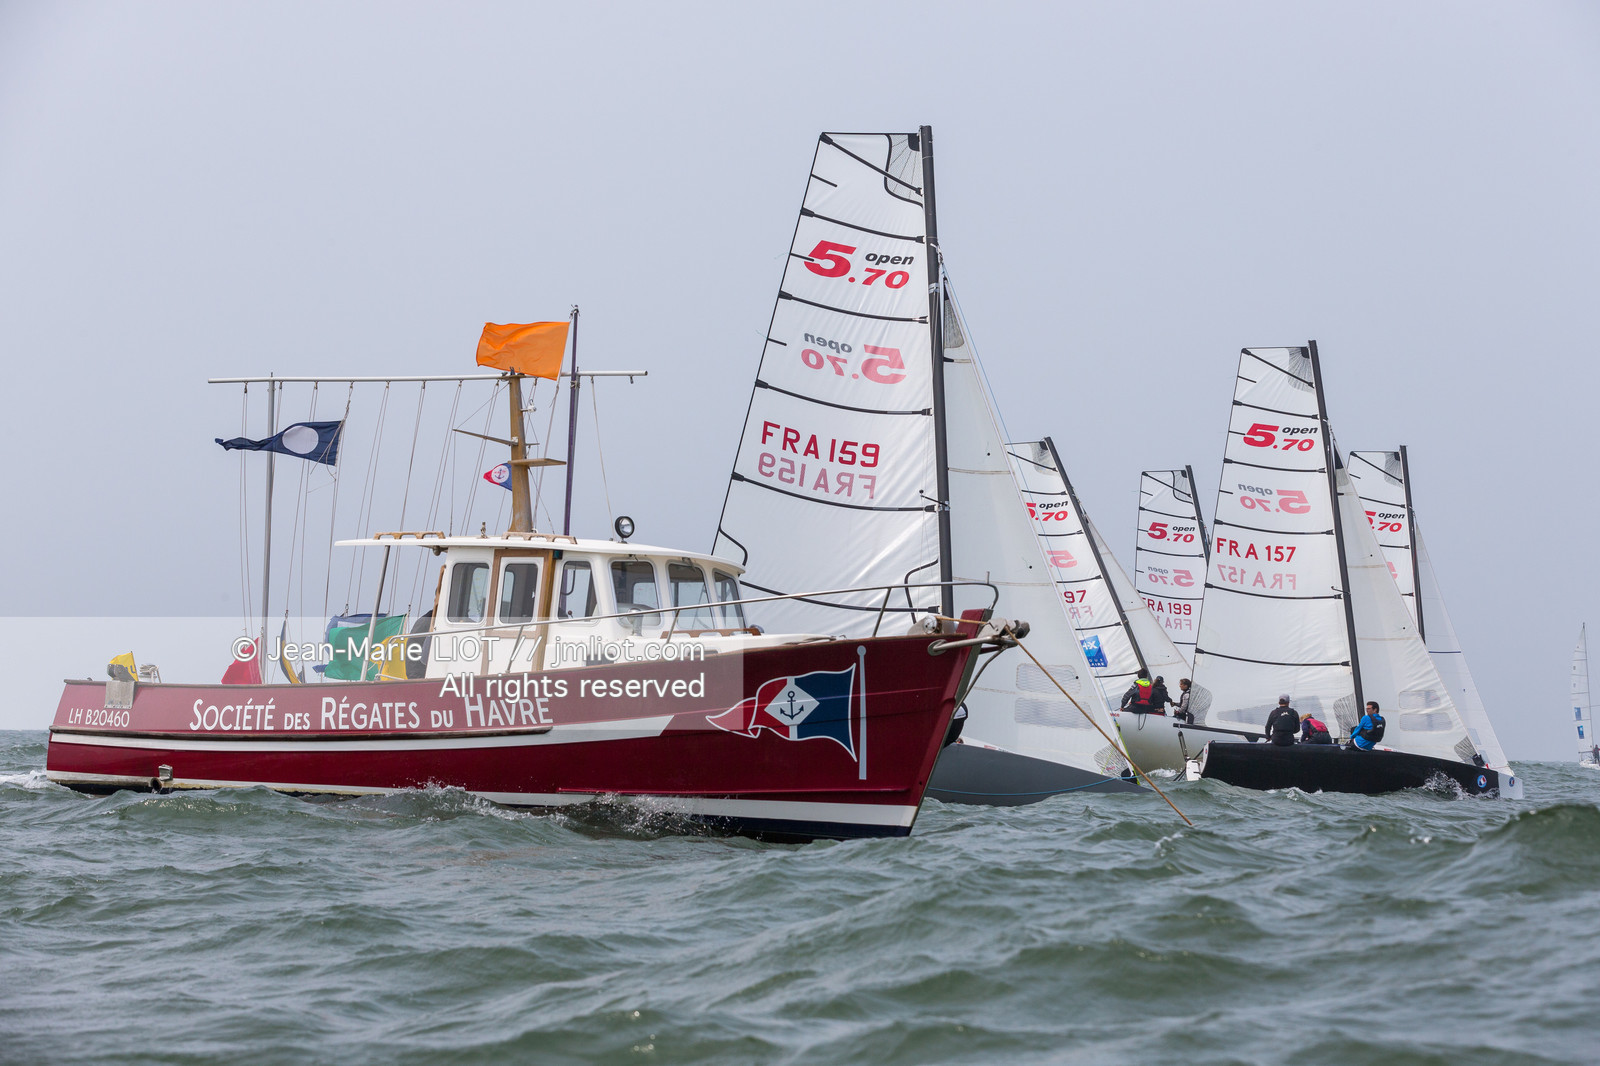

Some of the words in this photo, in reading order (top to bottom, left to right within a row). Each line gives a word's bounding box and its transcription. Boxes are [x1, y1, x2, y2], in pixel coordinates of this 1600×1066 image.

[804, 240, 910, 289] 5.70
[865, 252, 914, 266] open
[1243, 423, 1315, 452] 5.70
[1281, 426, 1318, 436] open
[761, 421, 820, 460] FRA
[829, 439, 880, 468] 159
[1039, 500, 1069, 510] open
[1378, 512, 1405, 520] open
[1147, 522, 1195, 543] 5.70
[1216, 538, 1259, 560] FRA
[1265, 545, 1297, 563] 157
[1168, 602, 1192, 616] 199
[68, 708, 82, 724] LH
[85, 709, 130, 728] B20460
[430, 710, 454, 728] DU
